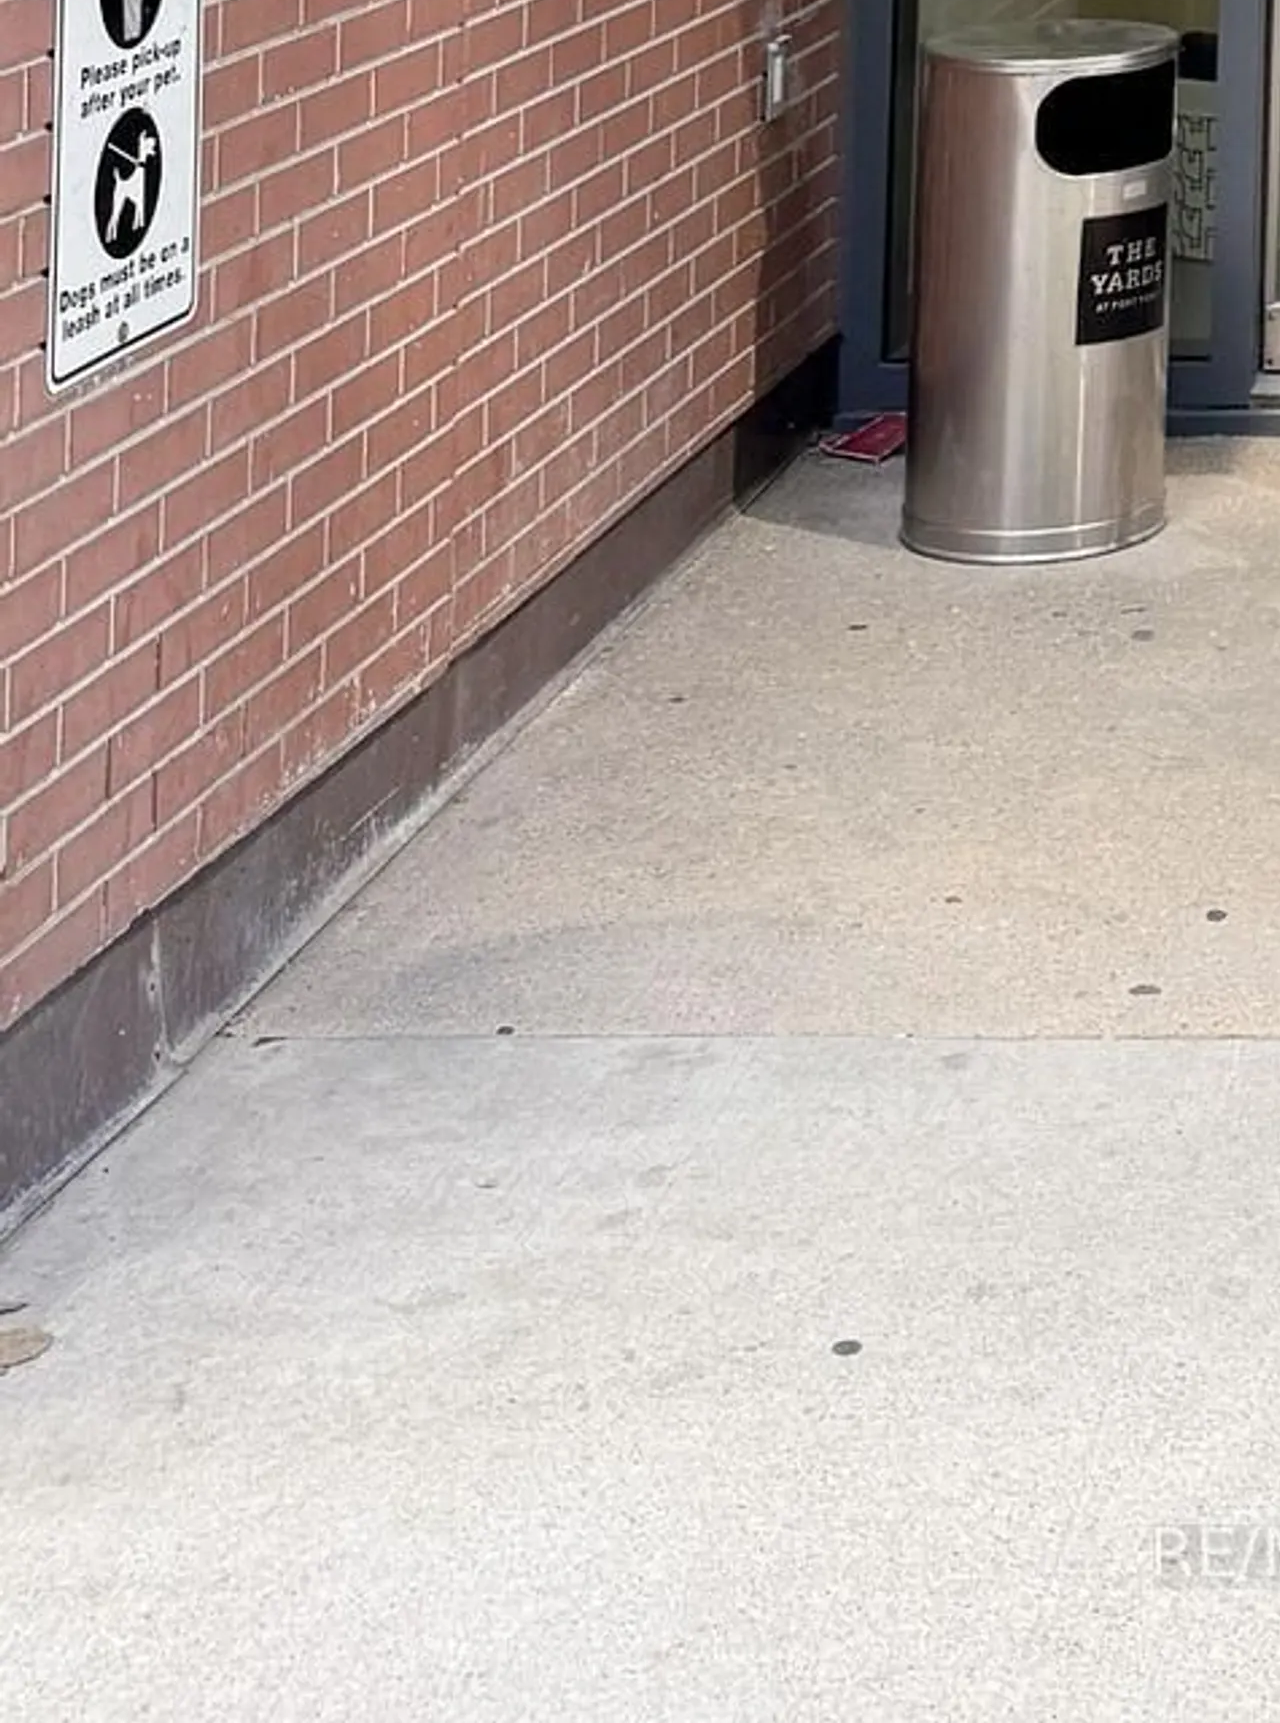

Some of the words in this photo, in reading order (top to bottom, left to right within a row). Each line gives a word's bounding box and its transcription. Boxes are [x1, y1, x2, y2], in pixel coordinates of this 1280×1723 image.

[80, 60, 128, 89] Please
[132, 39, 181, 75] pick-up
[81, 91, 115, 119] after
[120, 78, 151, 108] your
[154, 64, 181, 95] pet.
[60, 282, 95, 313] Dogs
[101, 259, 134, 293] must
[140, 251, 156, 274] be
[161, 242, 177, 263] on
[181, 236, 189, 253] a
[1106, 236, 1157, 266] THE
[1090, 259, 1163, 296] YARDS
[62, 305, 100, 342] leash
[105, 293, 120, 319] at
[123, 282, 141, 310] all
[144, 267, 186, 299] times.
